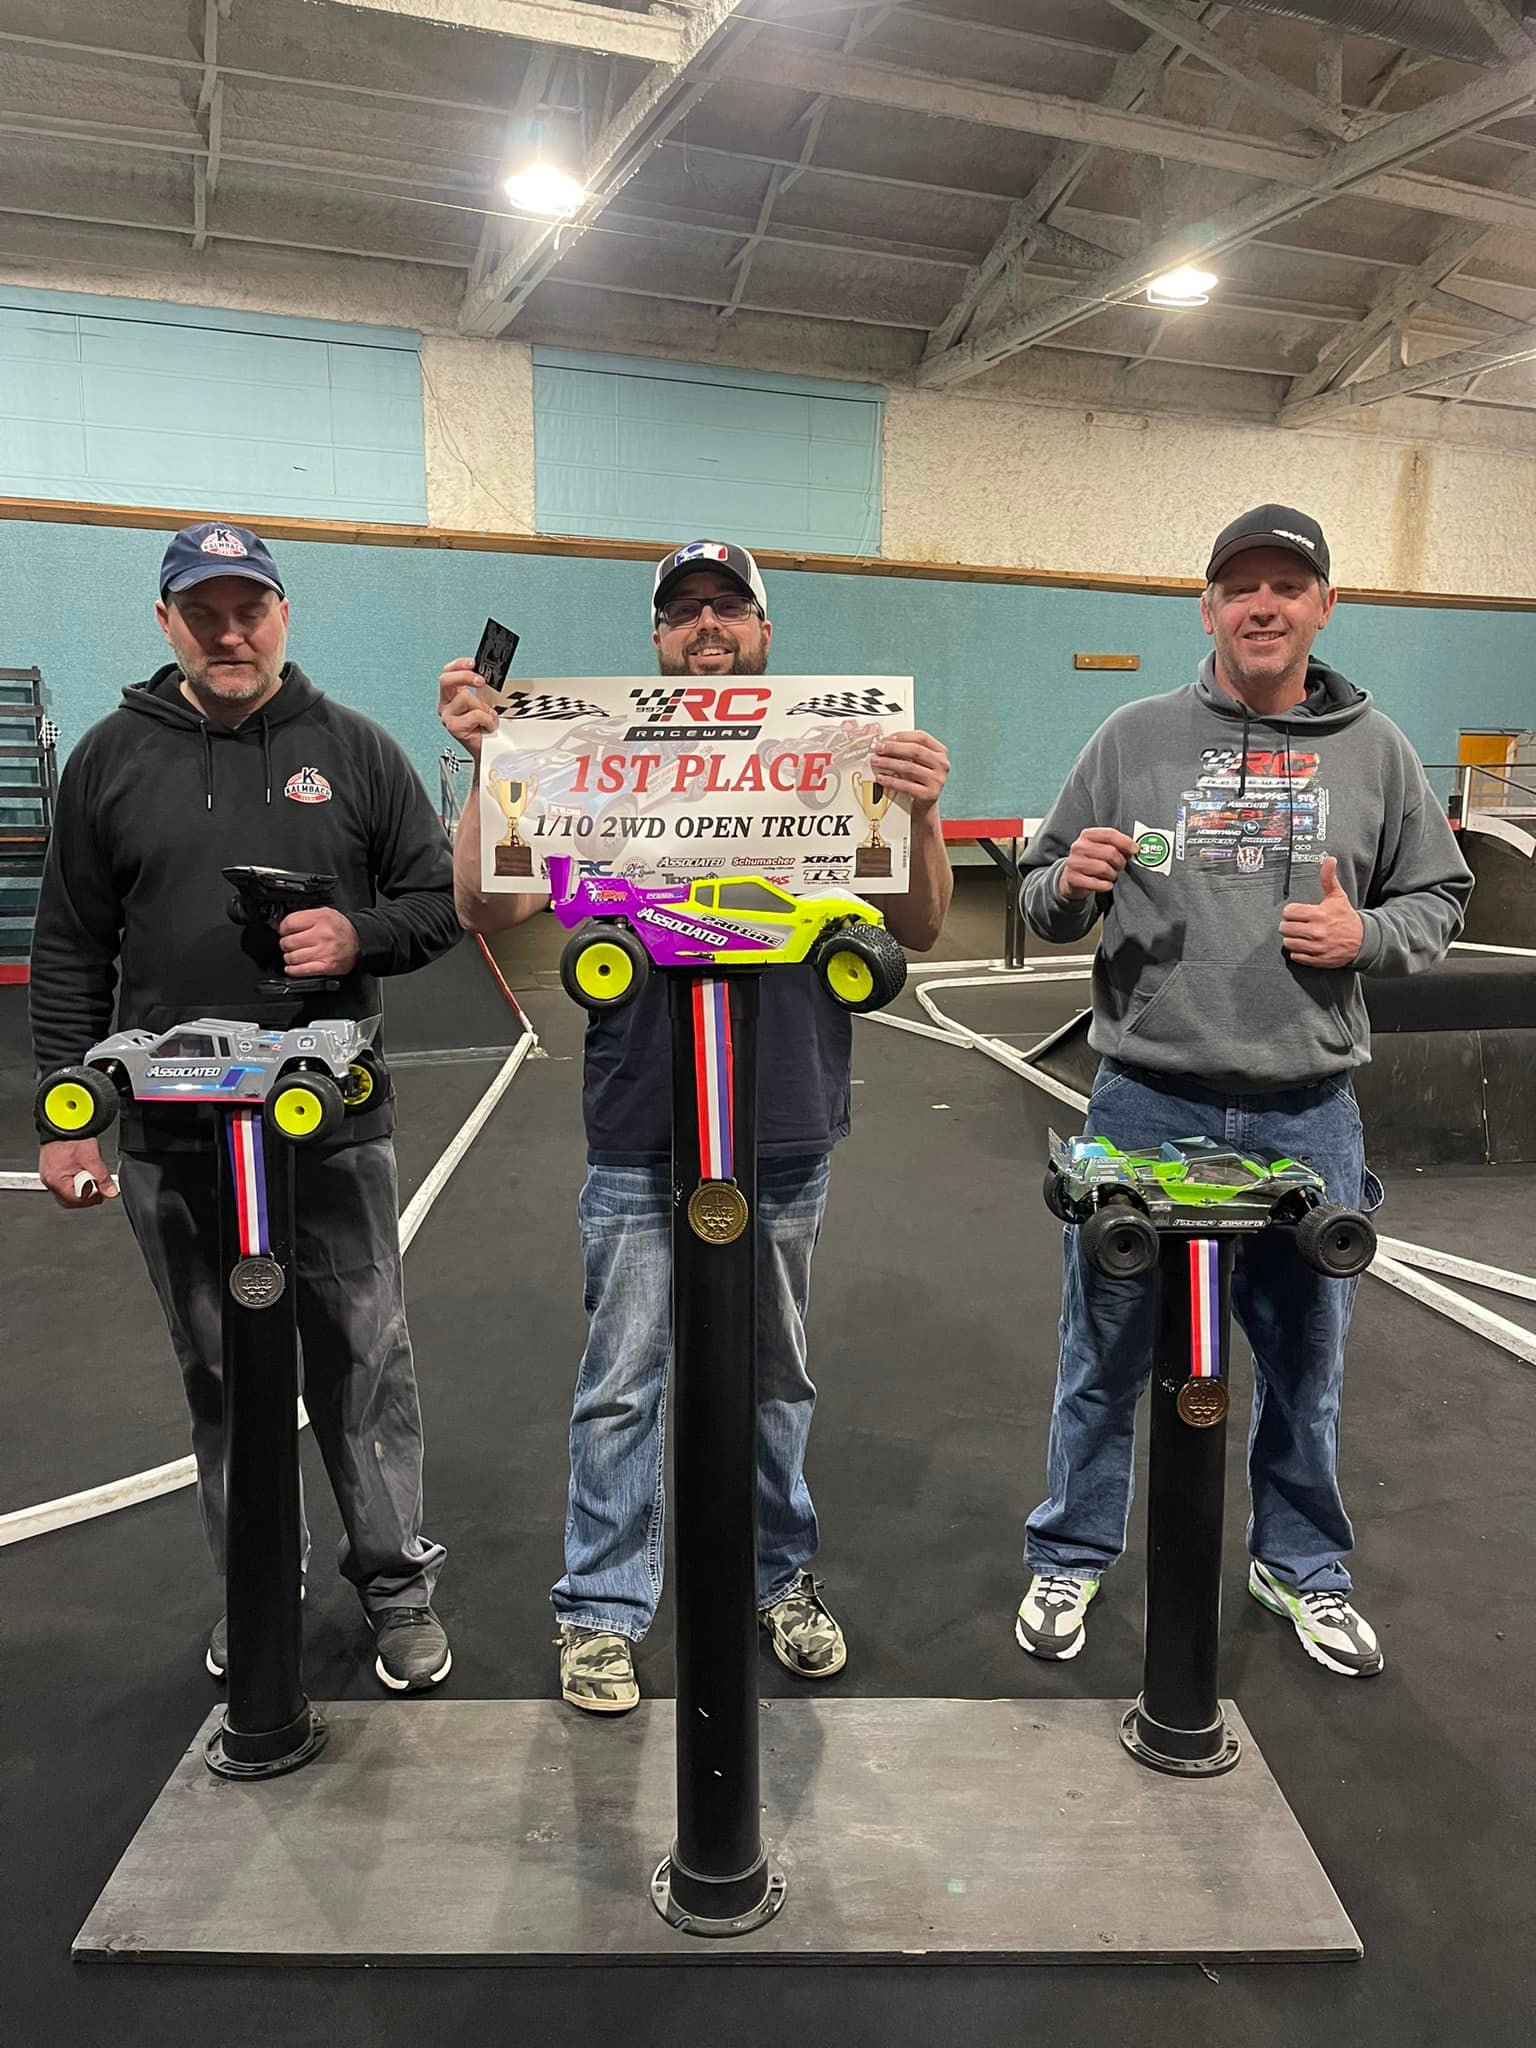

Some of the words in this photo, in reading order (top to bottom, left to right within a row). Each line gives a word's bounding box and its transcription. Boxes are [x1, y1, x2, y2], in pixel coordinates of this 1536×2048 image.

[216, 529, 230, 541] K
[682, 688, 772, 721] RC
[635, 729, 751, 738] RACEWAY
[302, 767, 319, 784] K
[569, 754, 661, 794] 1ST
[671, 753, 833, 793] PLACE
[285, 784, 332, 797] KALMBACH
[534, 814, 594, 837] 1/10
[600, 816, 666, 838] 2WD
[675, 816, 754, 838] OPEN
[761, 815, 854, 837] TRUCK
[1140, 844, 1163, 854] 3RD
[657, 857, 726, 868] ASSOCIATED
[731, 857, 795, 867] Schumacher
[802, 855, 855, 864] XRAY
[803, 869, 851, 881] TLR
[636, 907, 729, 947] ASSOCIATED
[147, 1065, 221, 1078] ASSOCIATED
